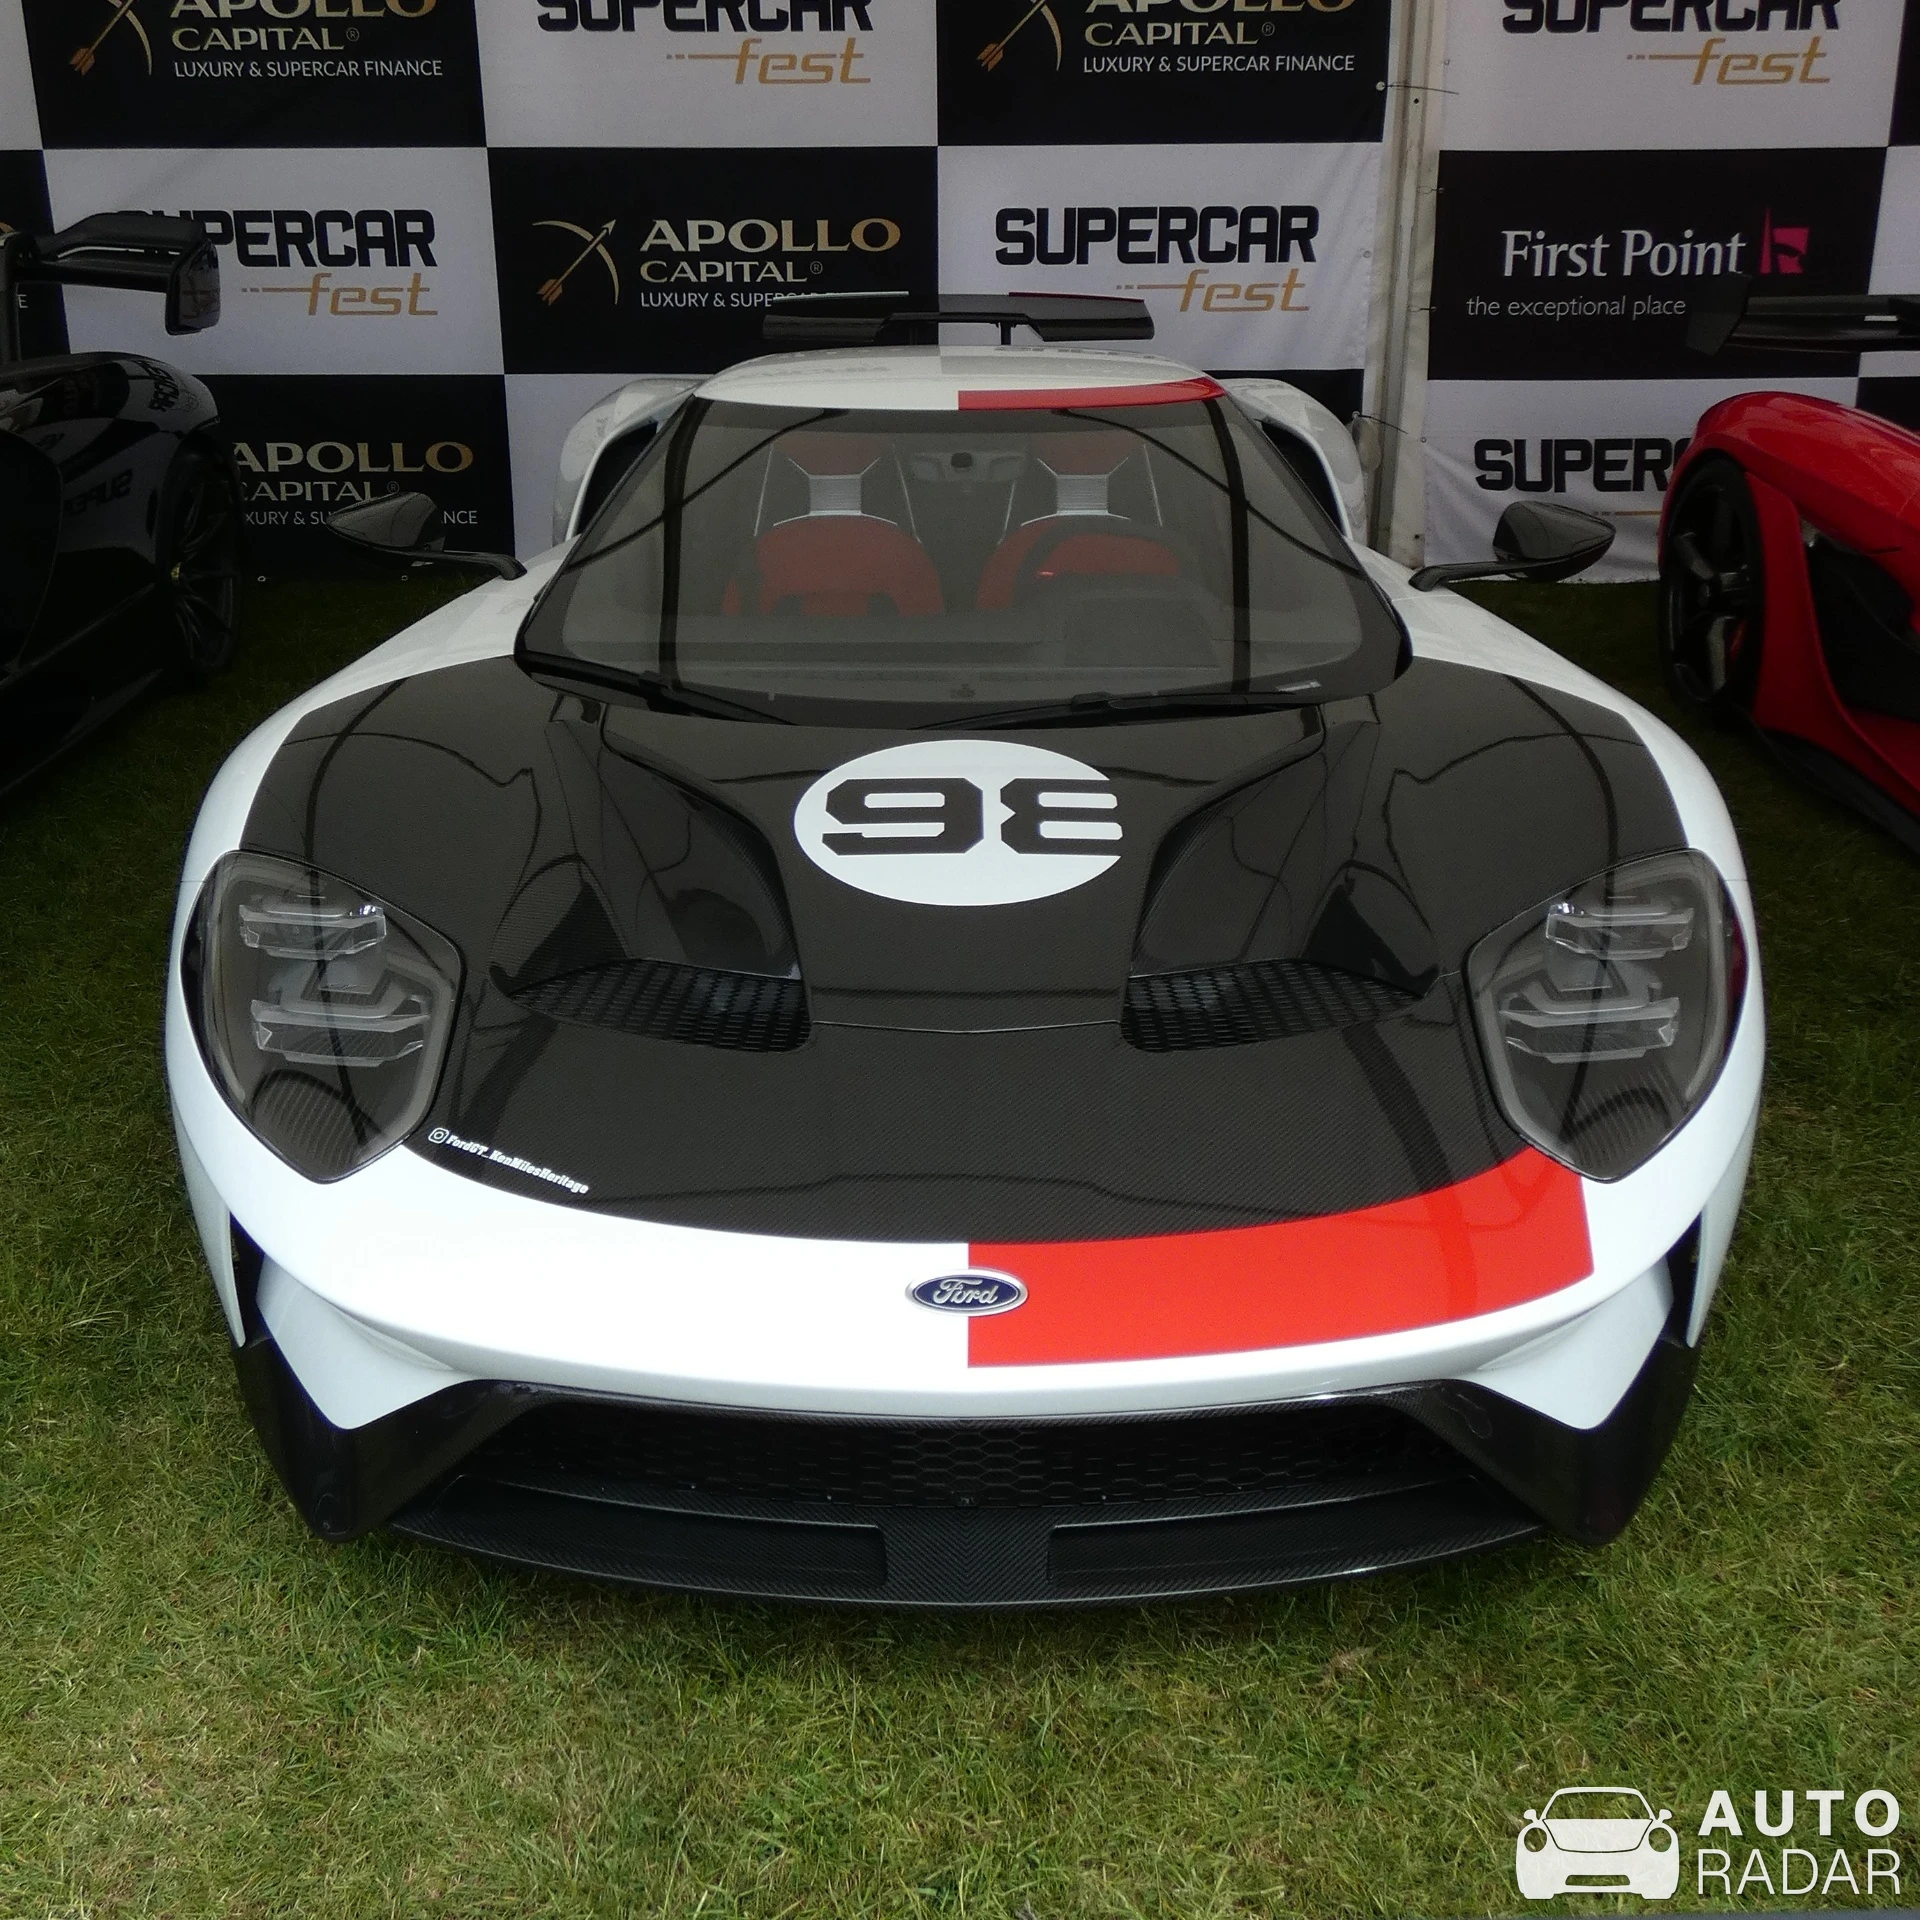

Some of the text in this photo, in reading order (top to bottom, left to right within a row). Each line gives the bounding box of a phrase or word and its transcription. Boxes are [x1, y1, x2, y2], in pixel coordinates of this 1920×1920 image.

[174, 59, 443, 77] LUXURY & SUPERCAR FINANCE
[735, 37, 871, 84] fest
[1083, 55, 1356, 73] LUXURY & SUPERCAR FINANCE
[1692, 36, 1830, 85] fest
[640, 217, 901, 253] APOLLO
[995, 205, 1320, 265] SUPERCAR
[1500, 228, 1746, 277] First Point
[308, 272, 438, 316] fest
[640, 292, 709, 308] LUXURY
[713, 292, 726, 308] &
[1179, 268, 1309, 312] fest
[1466, 294, 1686, 321] the exceptional place
[232, 441, 474, 473] APOLLO
[1474, 438, 1690, 493] SUPER
[293, 511, 305, 525] &
[933, 1279, 999, 1304] Ford
